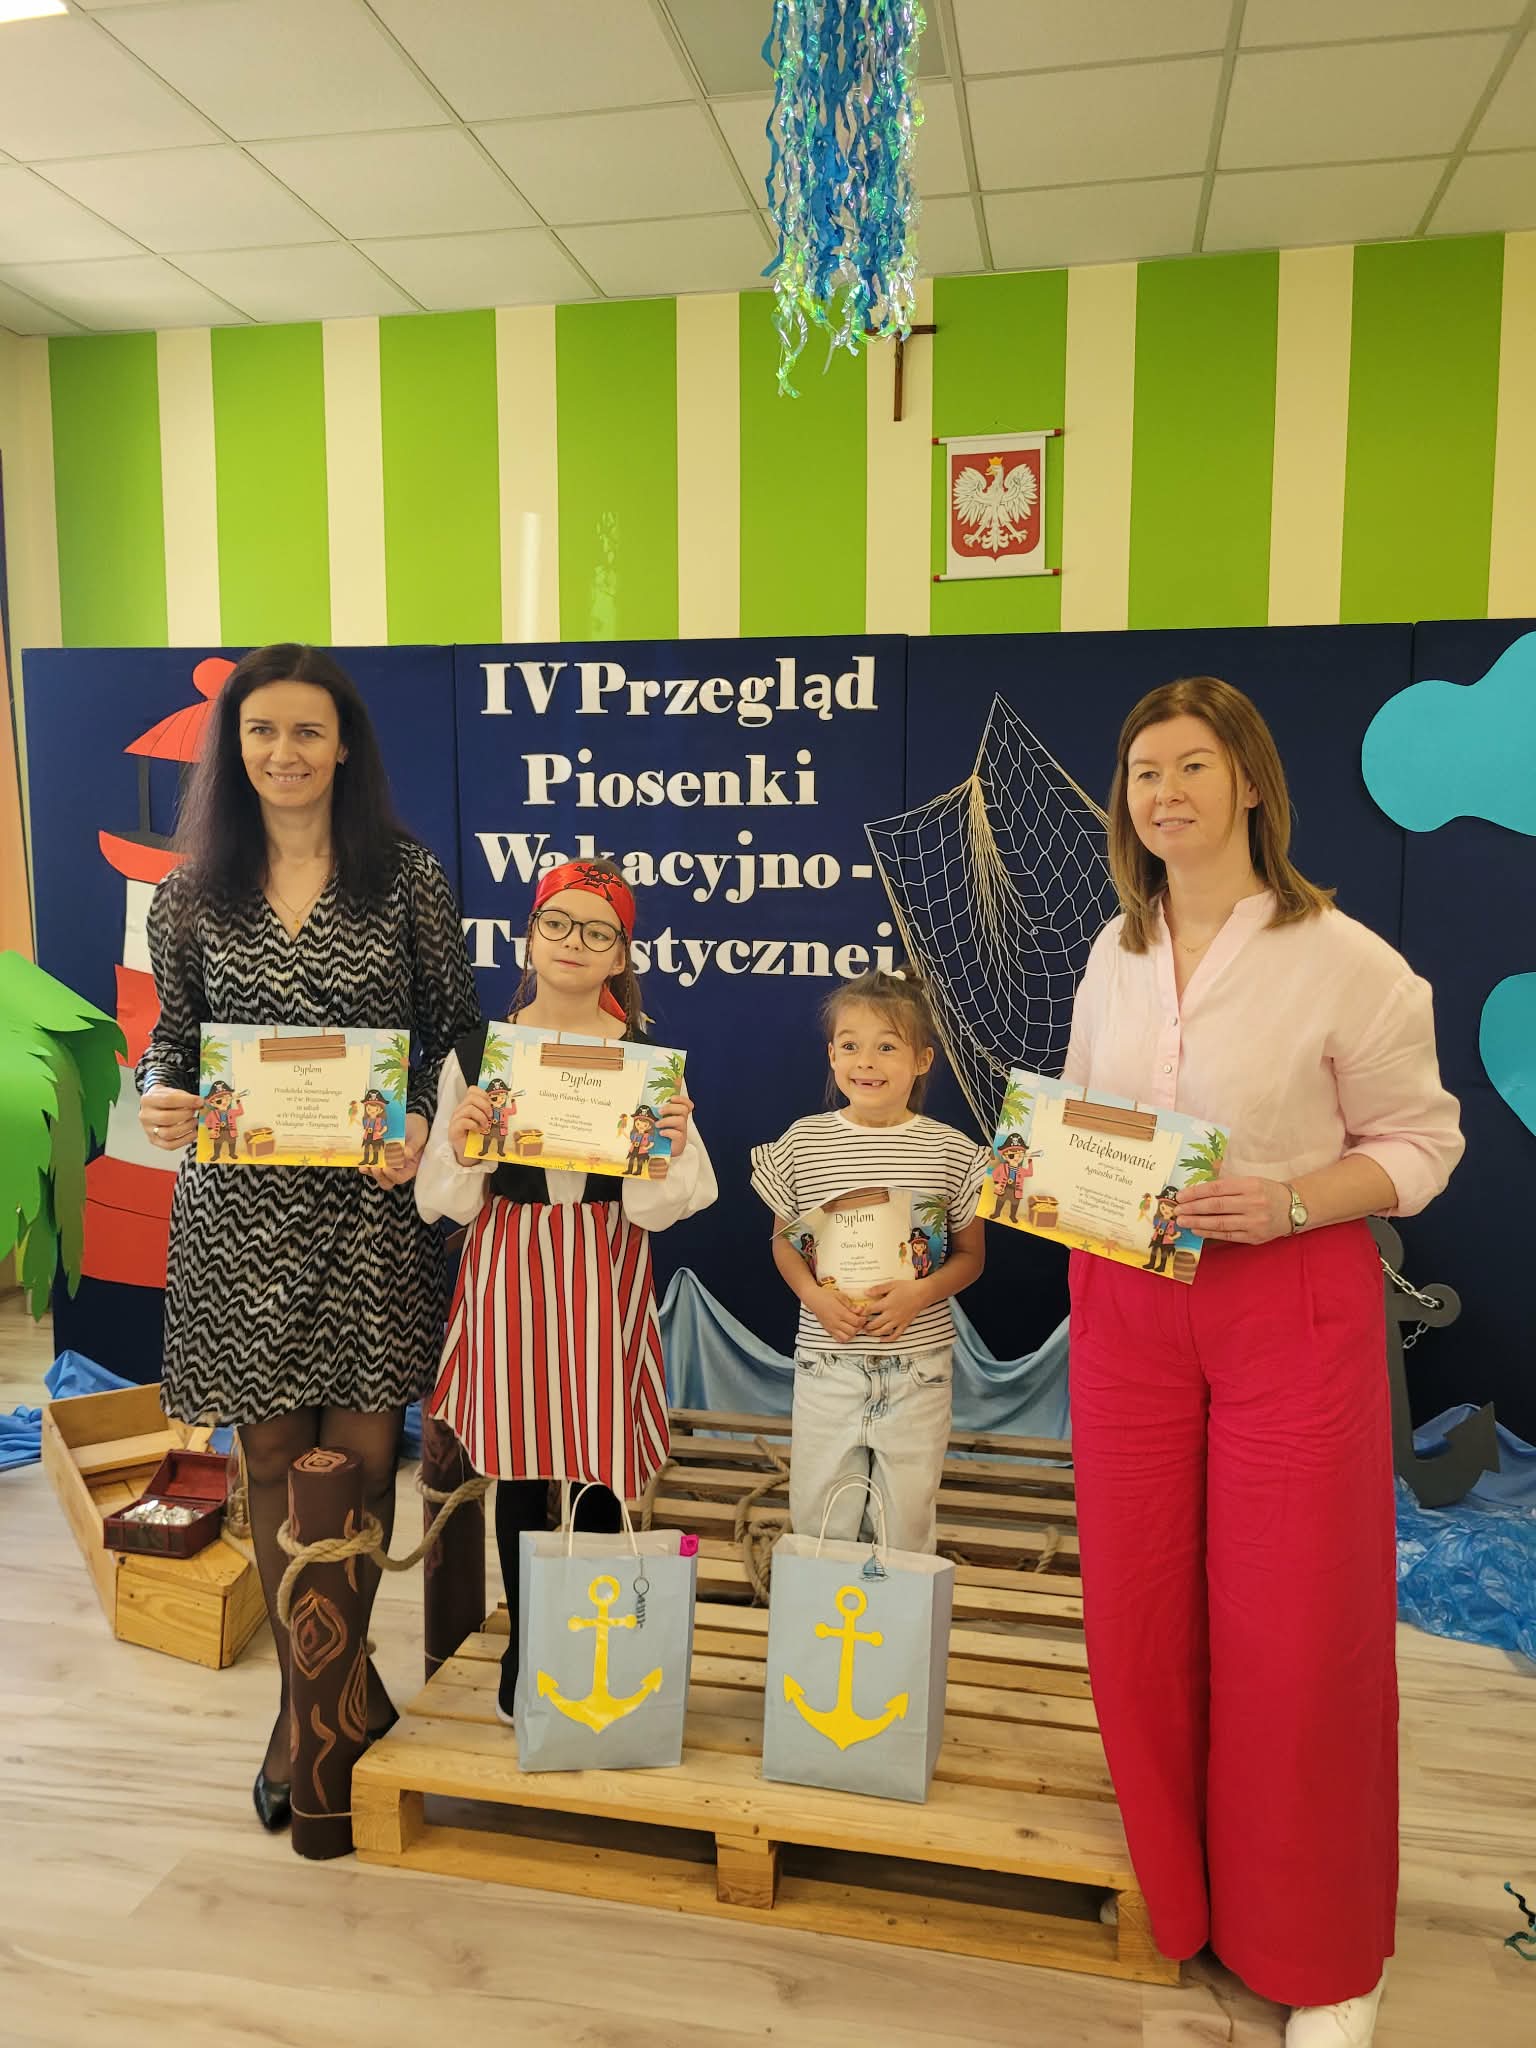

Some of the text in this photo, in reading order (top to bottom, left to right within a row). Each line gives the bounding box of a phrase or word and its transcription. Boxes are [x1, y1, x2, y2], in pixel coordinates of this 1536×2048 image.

[478, 655, 879, 728] IV Przegląd
[521, 747, 819, 808] Piosenki
[293, 1063, 322, 1076] Dyplom
[560, 1071, 602, 1088] Dyplom
[1068, 1133, 1156, 1170] Podziękowanie
[835, 1209, 874, 1228] Dyplom
